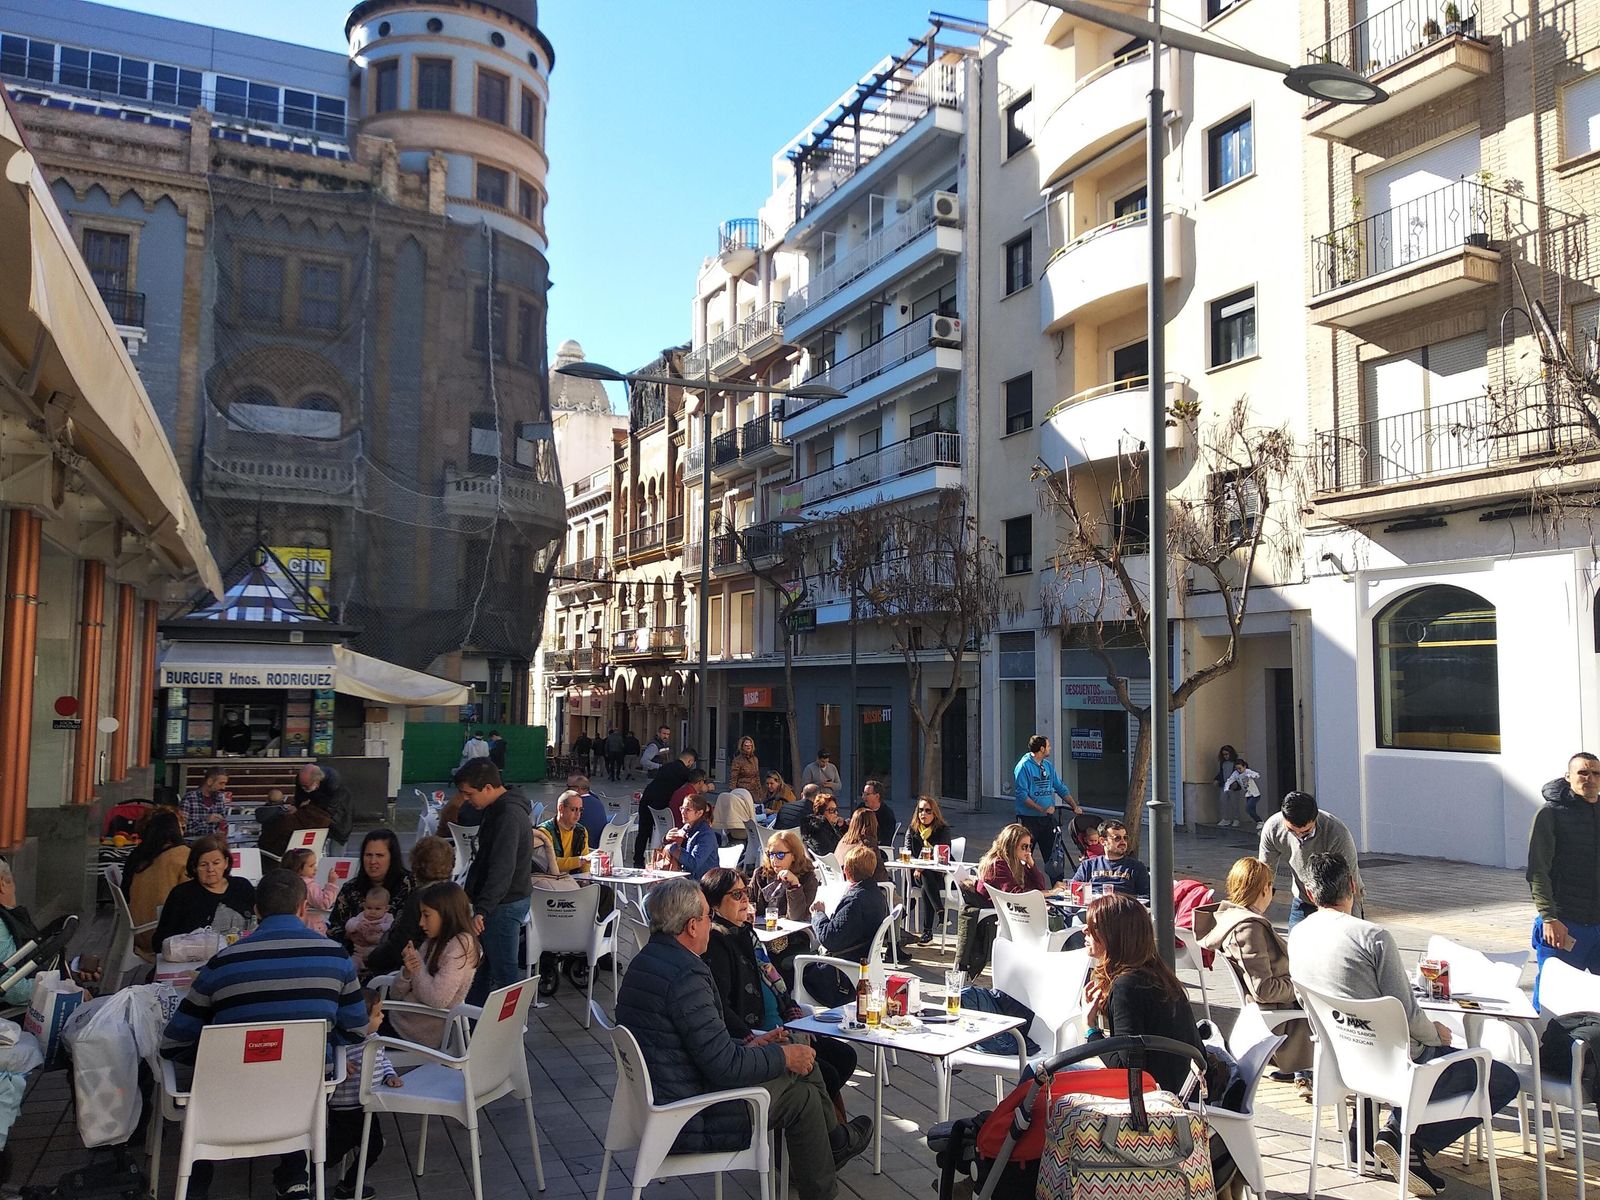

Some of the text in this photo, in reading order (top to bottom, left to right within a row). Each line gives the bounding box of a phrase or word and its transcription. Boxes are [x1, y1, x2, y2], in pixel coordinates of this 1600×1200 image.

[166, 671, 331, 686] BURGUER Hnos. RODRIGUEZ
[1065, 685, 1100, 695] DESCUENTOS
[1072, 740, 1102, 749] DISPONIBLE
[1347, 1016, 1374, 1031] MAX
